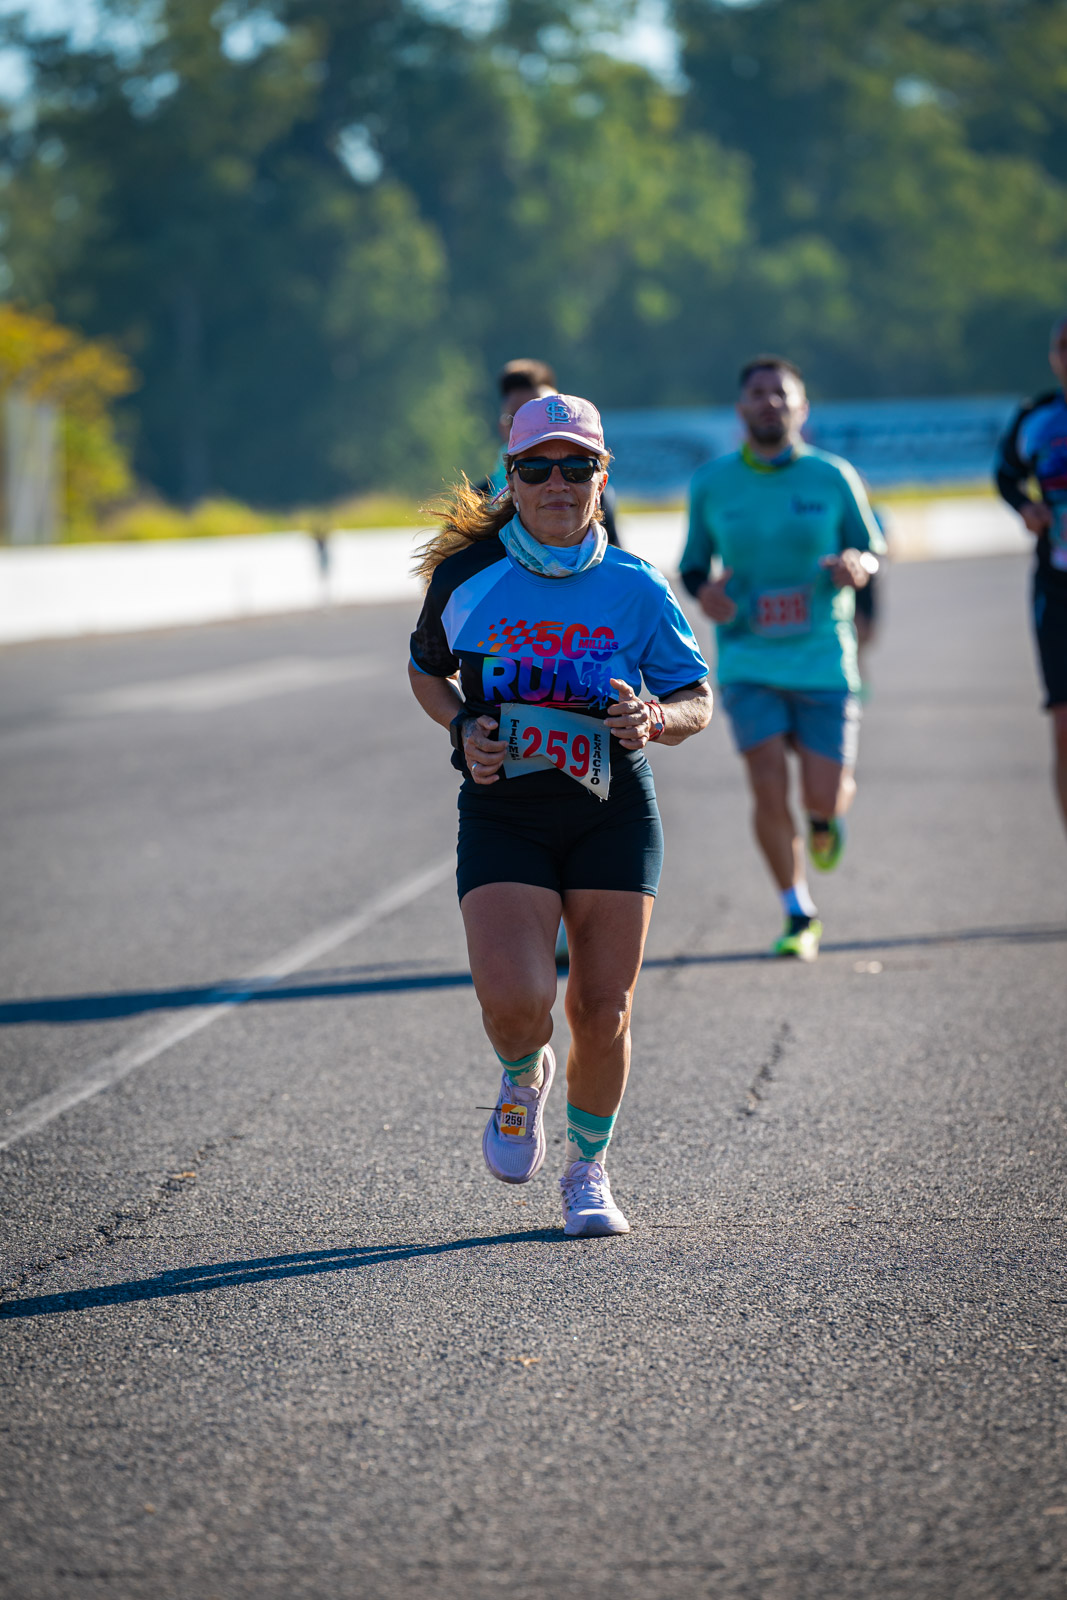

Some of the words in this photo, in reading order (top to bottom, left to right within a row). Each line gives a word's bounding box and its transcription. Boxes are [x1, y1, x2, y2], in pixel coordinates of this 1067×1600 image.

[578, 639, 619, 650] MILLAS
[482, 656, 597, 701] RUN
[508, 719, 521, 760] TIEMP
[521, 726, 591, 778] 259
[590, 733, 602, 785] EXACTO
[504, 1114, 522, 1126] 259
